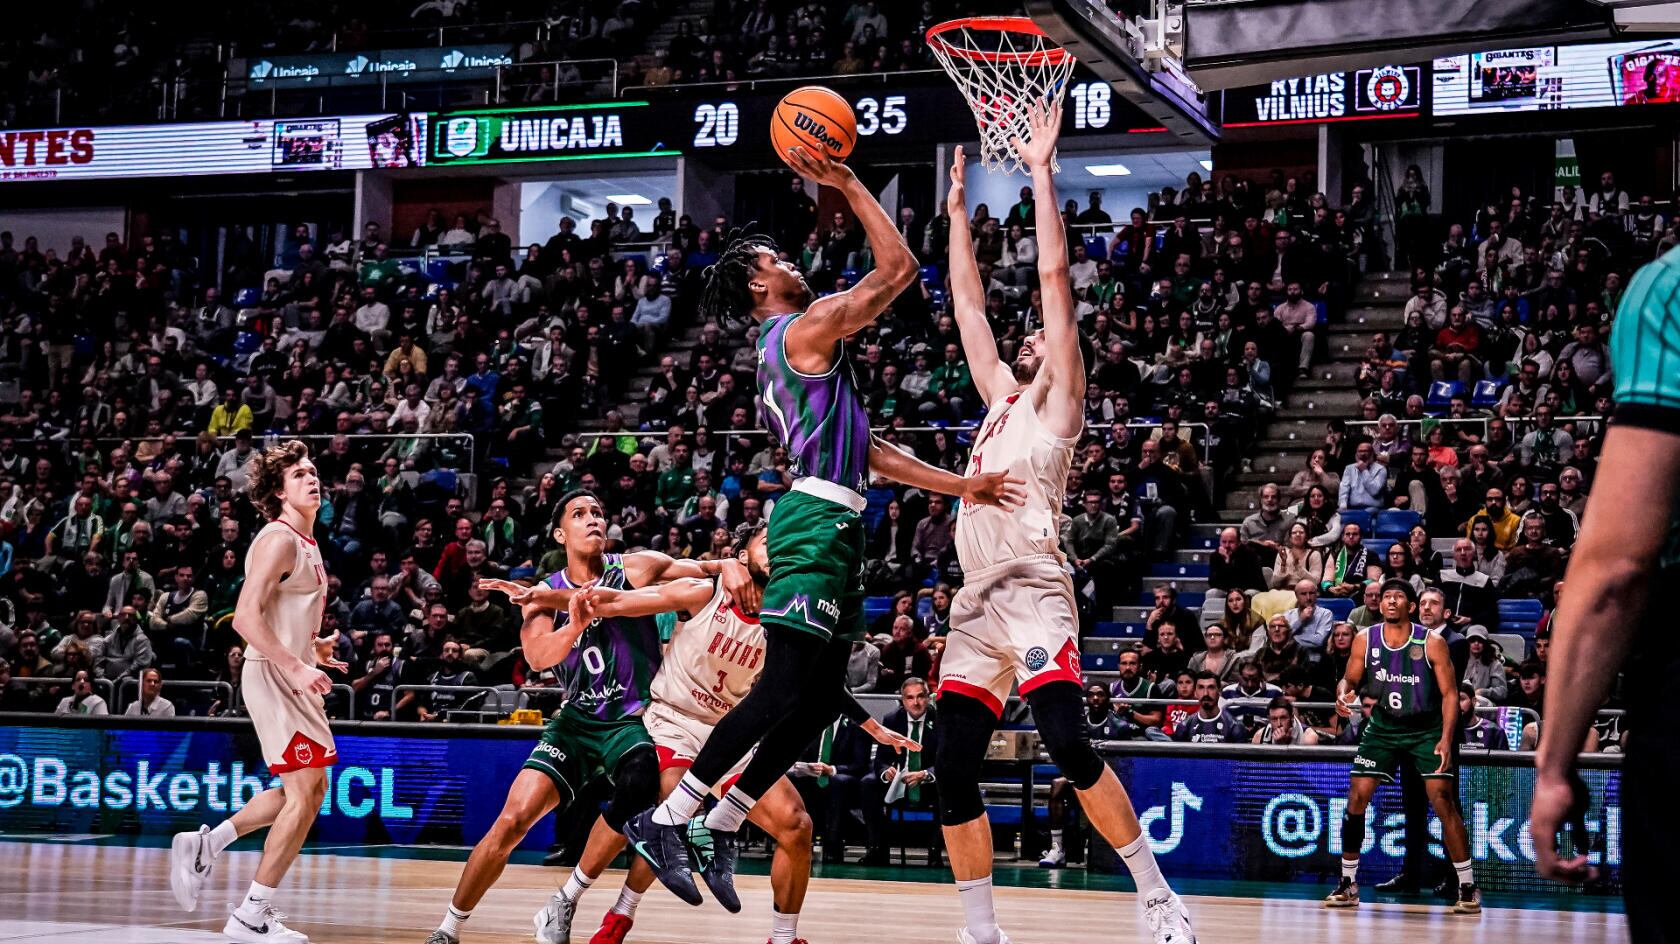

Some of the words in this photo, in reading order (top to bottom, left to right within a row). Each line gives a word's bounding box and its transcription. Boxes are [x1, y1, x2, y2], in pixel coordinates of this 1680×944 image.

[274, 65, 319, 81] Unicaja
[369, 60, 416, 76] Unicaja
[464, 55, 512, 71] Unicaja
[856, 96, 907, 136] 35
[1070, 82, 1111, 129] 18
[1255, 93, 1345, 121] VILNIUS
[500, 115, 623, 152] UNICAJA
[694, 103, 739, 147] 20
[794, 111, 843, 152] Wilson
[582, 646, 606, 675] 0
[707, 632, 763, 669] RYTAS
[712, 669, 728, 693] 3
[1386, 673, 1420, 686] Unicaja
[371, 693, 380, 706] 0
[1388, 692, 1402, 709] 6
[535, 740, 567, 762] álaga
